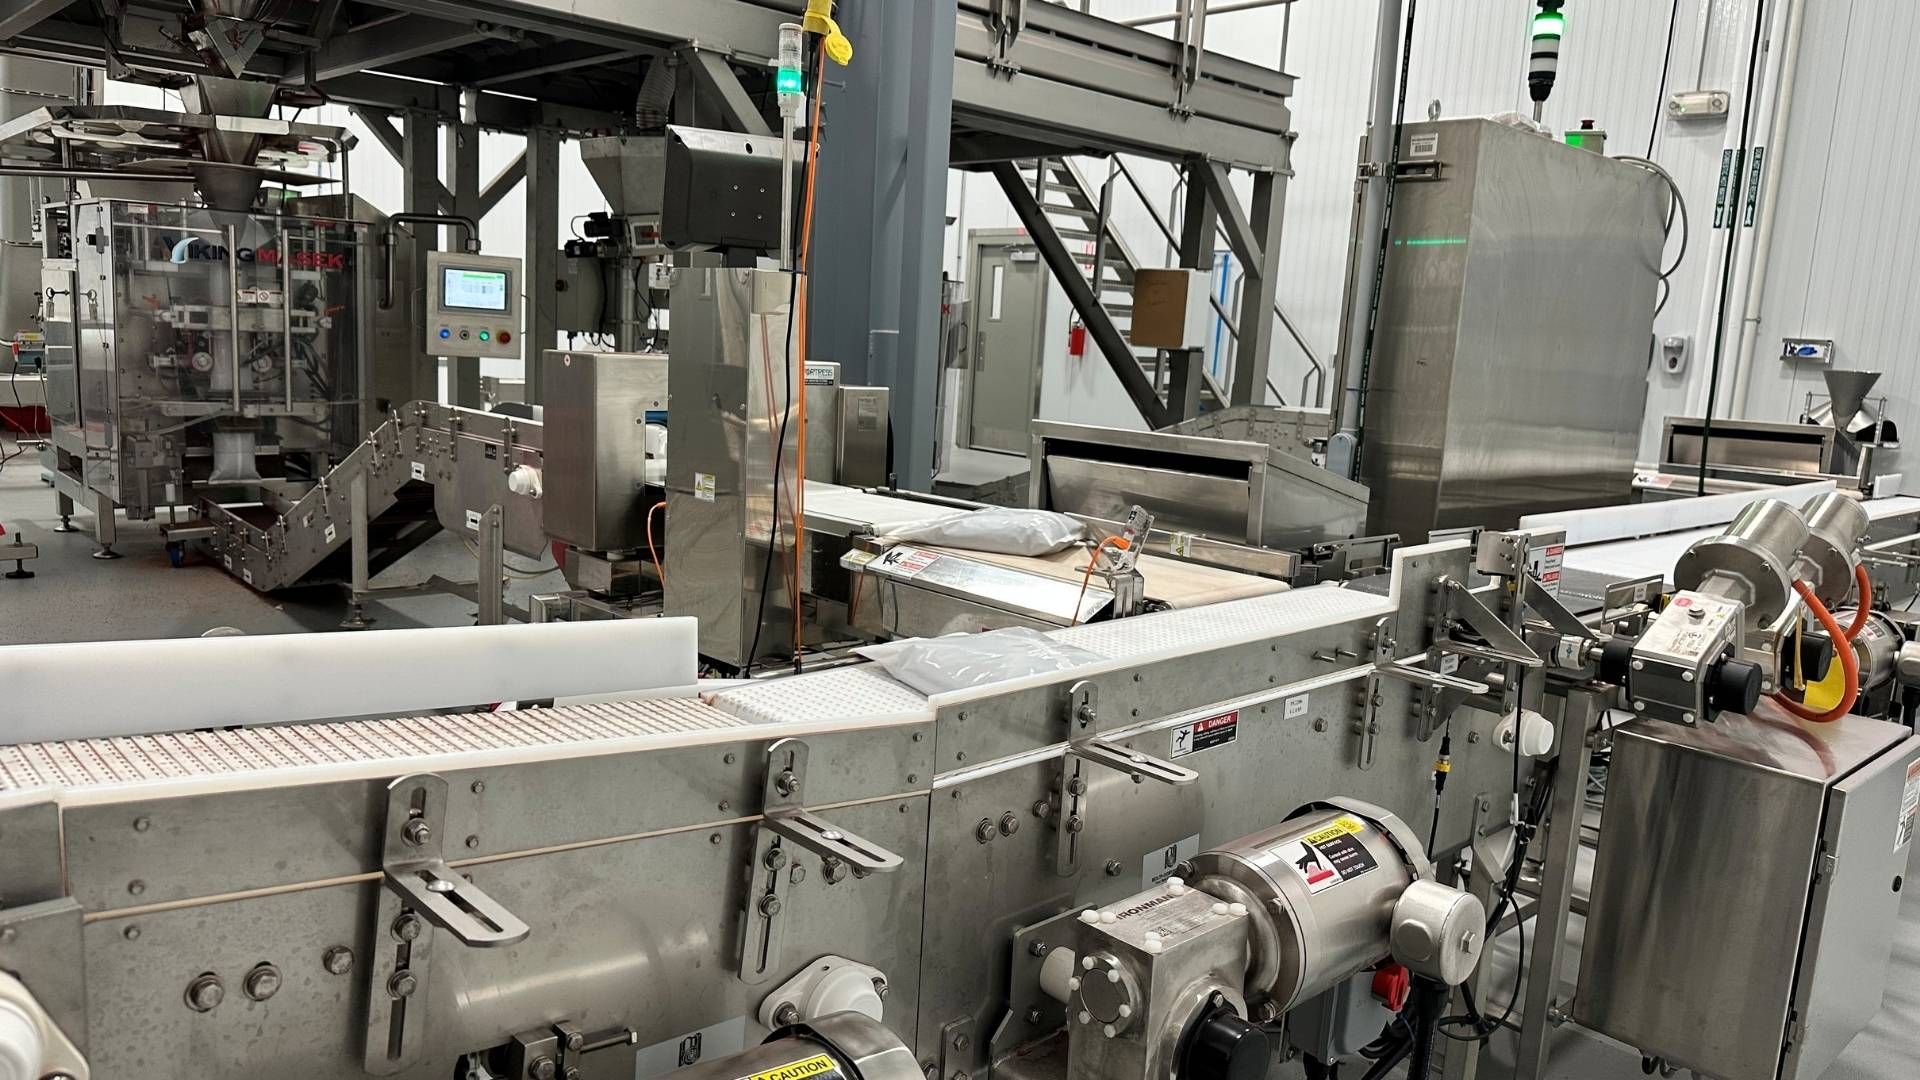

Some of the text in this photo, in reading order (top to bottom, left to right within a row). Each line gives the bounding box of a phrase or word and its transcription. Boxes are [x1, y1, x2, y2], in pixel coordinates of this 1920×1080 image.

[805, 368, 833, 377] ORTRESS
[1208, 715, 1232, 728] DANGER
[1315, 828, 1343, 841] CAUTION
[1116, 893, 1174, 920] IRONMAN
[769, 1060, 828, 1080] CAUTION
